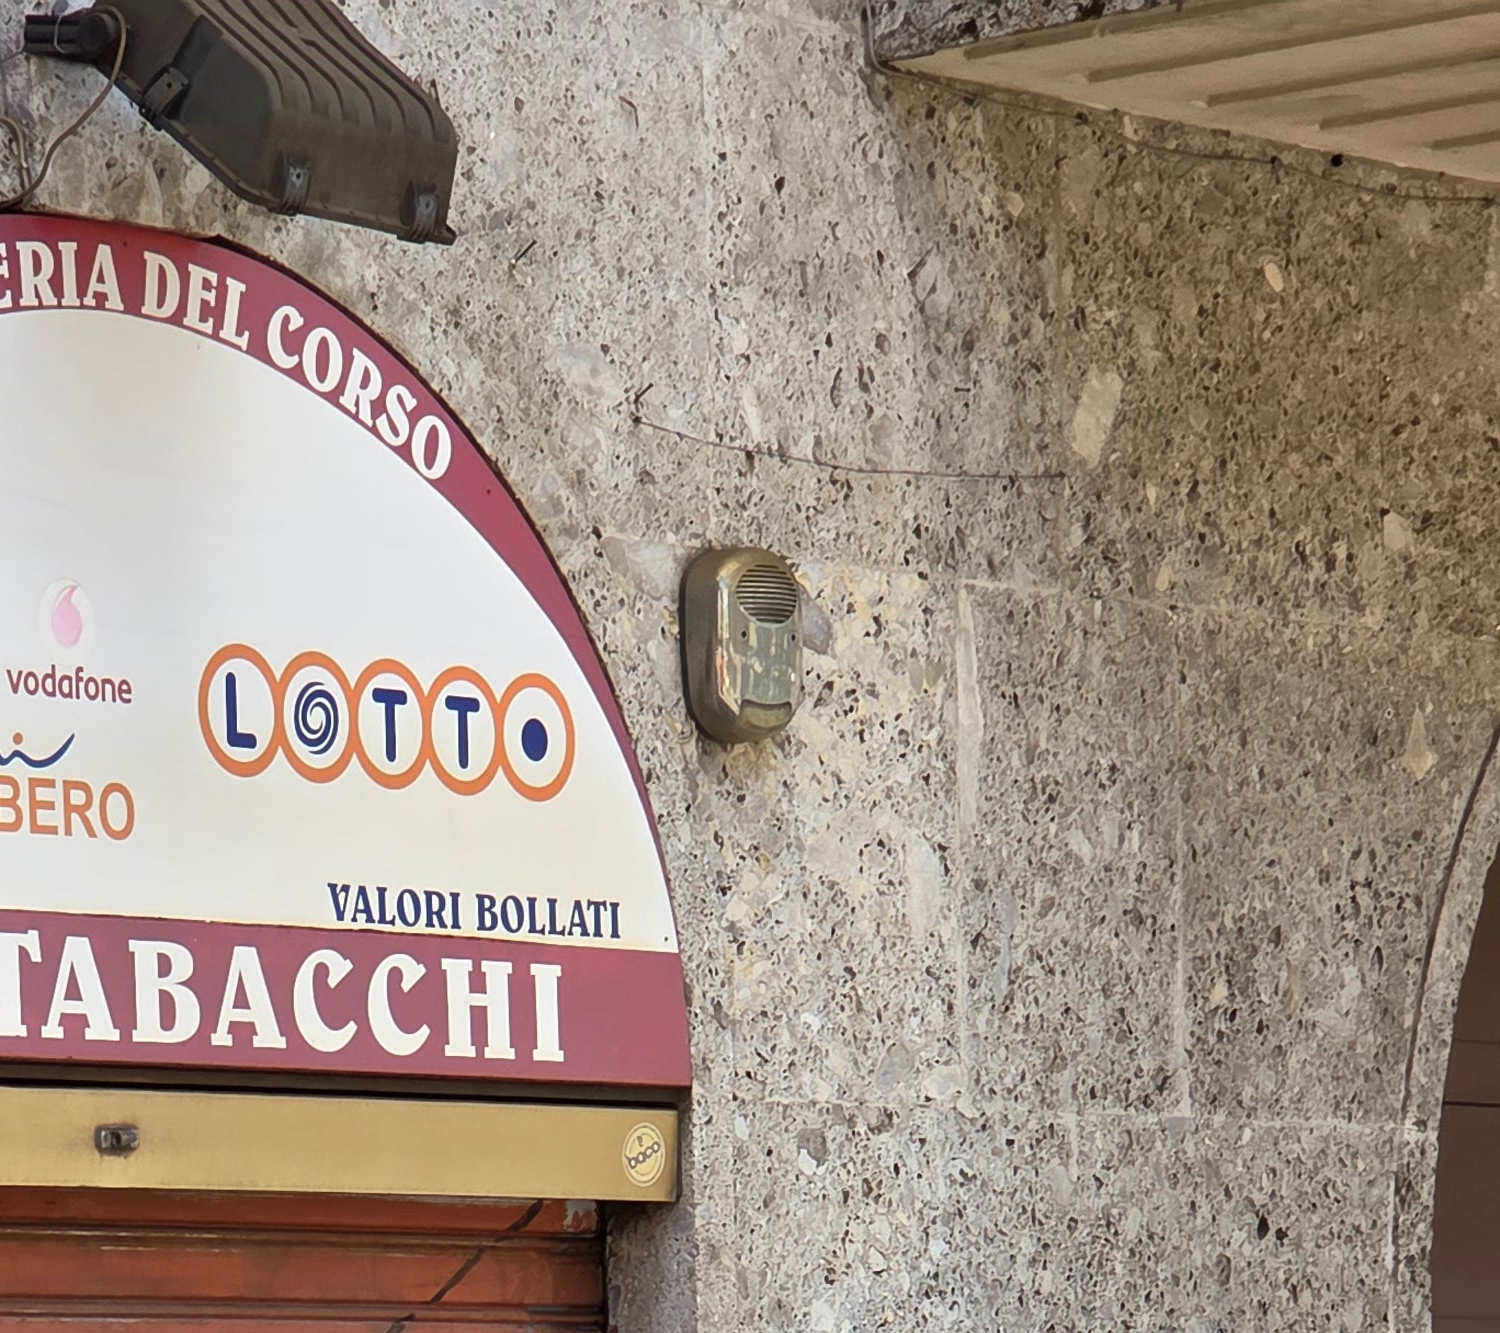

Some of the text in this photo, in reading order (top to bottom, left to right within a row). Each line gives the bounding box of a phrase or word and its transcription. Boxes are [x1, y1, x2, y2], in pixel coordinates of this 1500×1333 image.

[143, 252, 250, 350] DEL
[267, 305, 453, 481] CORSO
[6, 665, 132, 704] vodafone
[203, 648, 572, 798] LOTTO
[328, 882, 621, 939] VALORI BOLLATI
